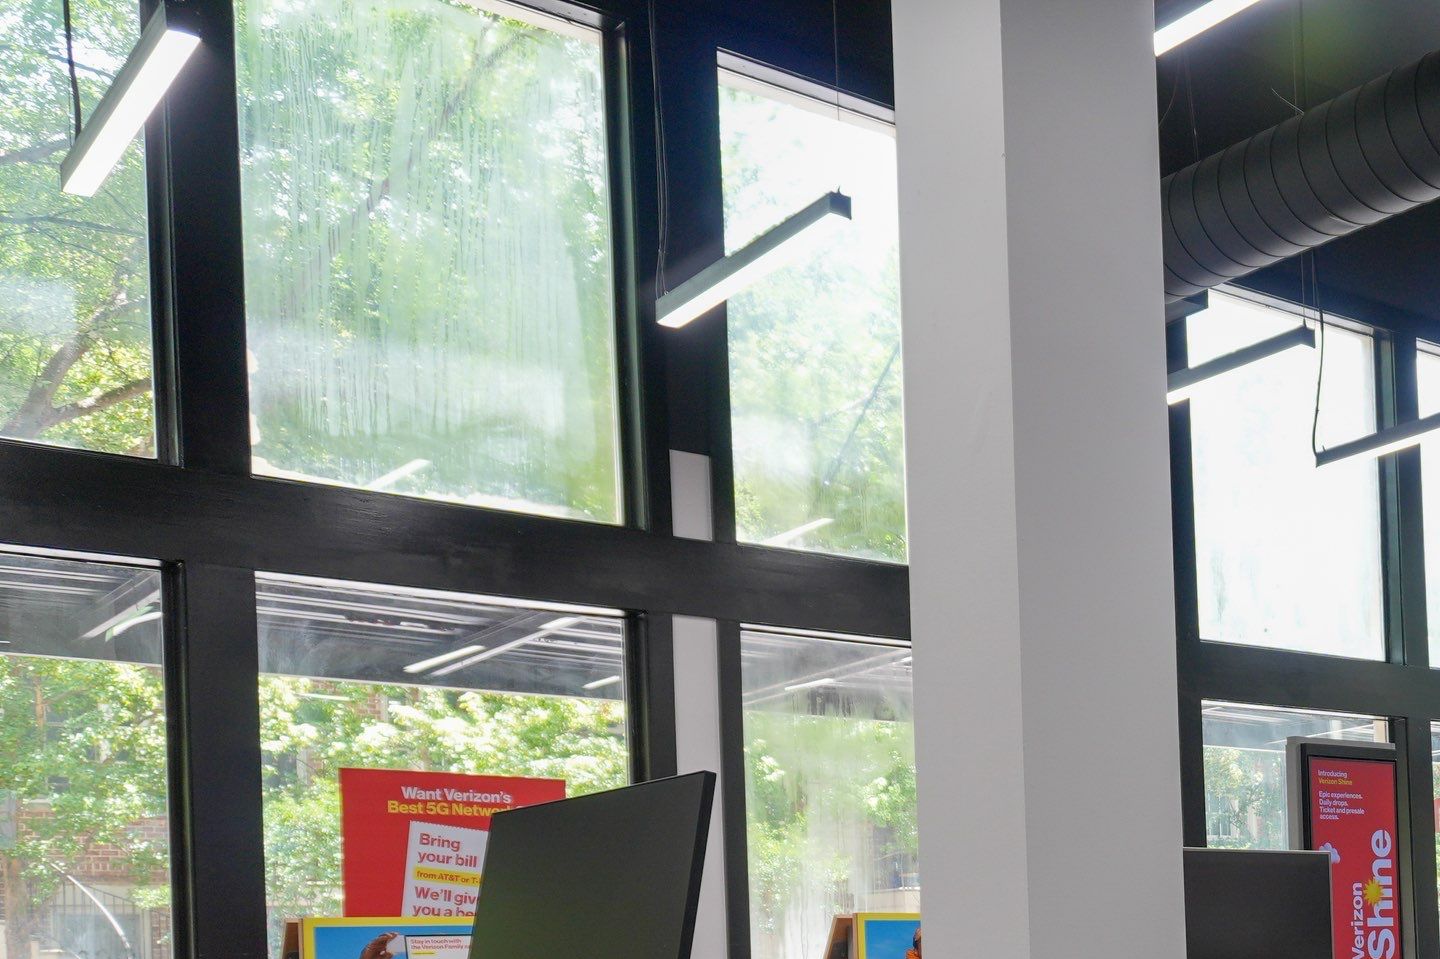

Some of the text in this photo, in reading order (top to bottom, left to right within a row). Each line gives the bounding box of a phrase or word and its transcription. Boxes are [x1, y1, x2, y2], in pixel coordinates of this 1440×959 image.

[1317, 770, 1348, 778] Introducing
[401, 786, 442, 800] Want
[1318, 790, 1331, 799] Epic
[387, 800, 424, 814] Best
[426, 801, 449, 816] 5G
[419, 832, 461, 851] Bring
[417, 851, 478, 868] your bill
[416, 869, 437, 880] from
[438, 872, 460, 883] AT&T
[454, 889, 480, 906] giv
[412, 903, 442, 916] you
[444, 907, 453, 917] a
